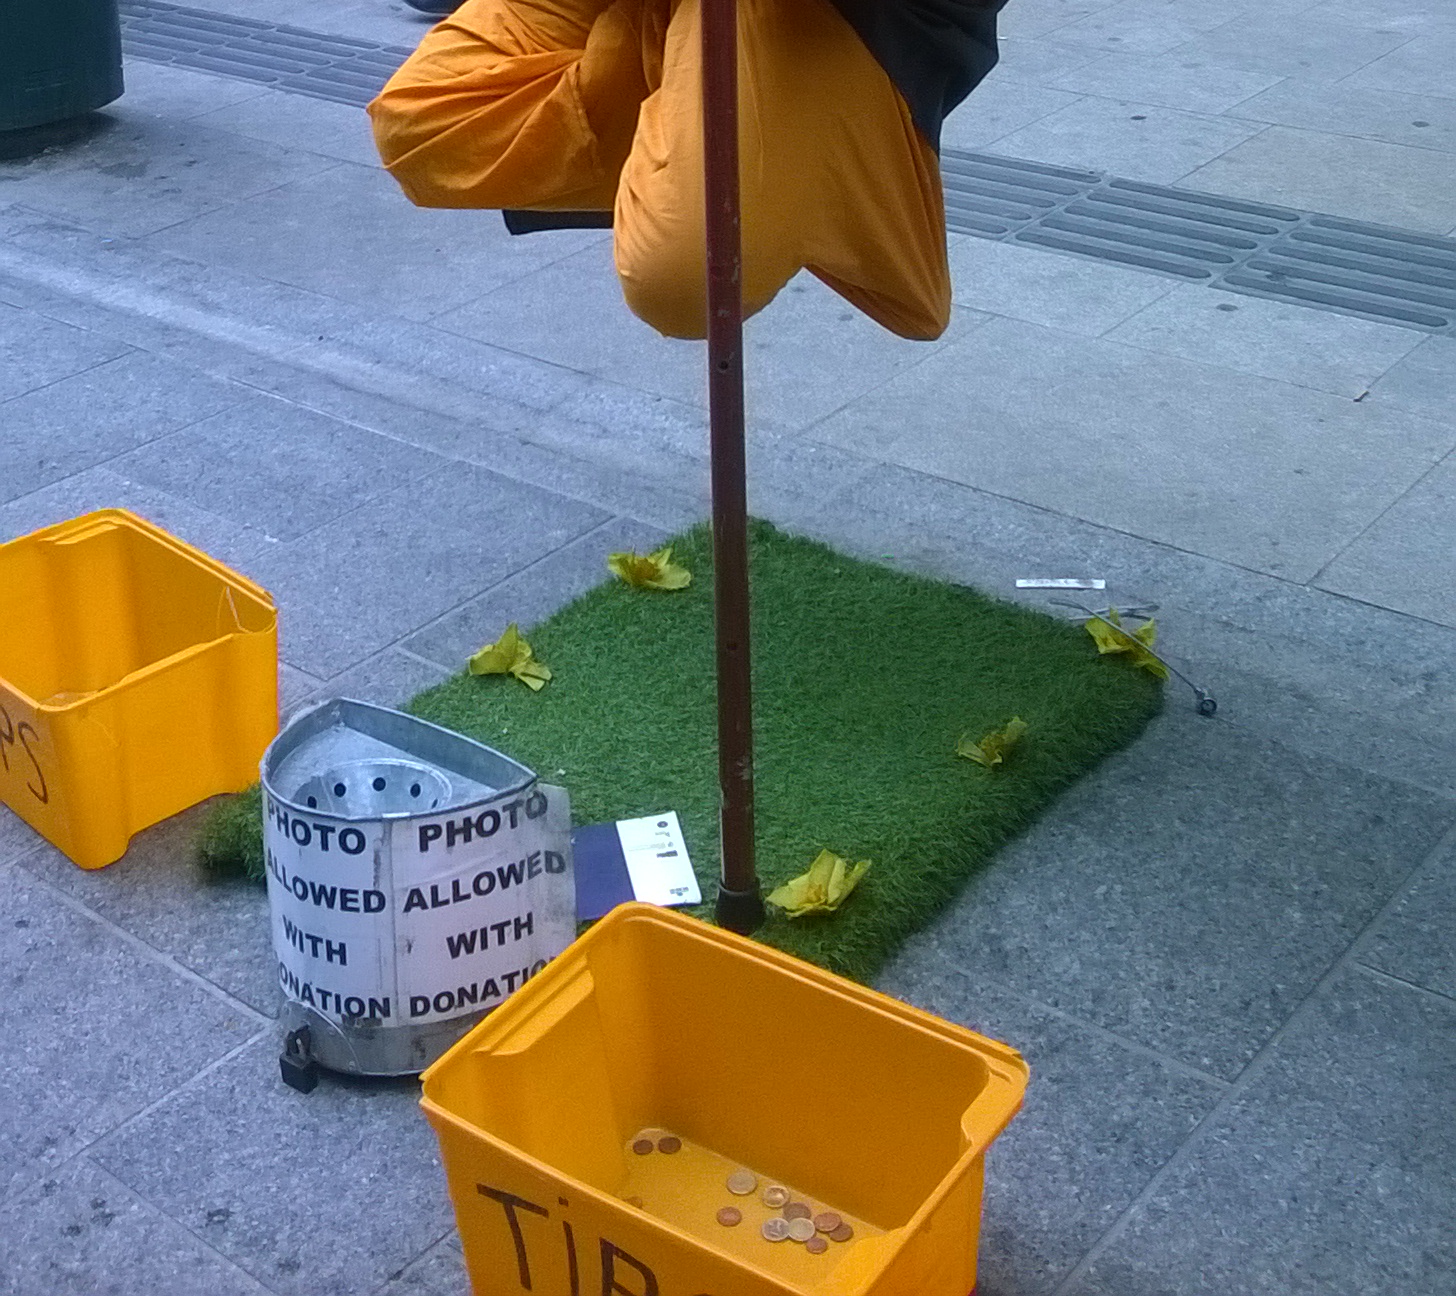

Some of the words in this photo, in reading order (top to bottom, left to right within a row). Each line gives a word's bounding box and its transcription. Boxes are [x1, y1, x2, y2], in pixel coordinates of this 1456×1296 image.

[267, 797, 366, 855] PHOTO
[418, 791, 549, 853] PHOTO
[267, 847, 386, 914] ALLOWED
[403, 850, 567, 914] ALLOWED
[283, 914, 348, 966] WITH
[446, 912, 534, 960] WITH
[276, 954, 391, 1020] ONATION
[409, 956, 556, 1018] DONATIO
